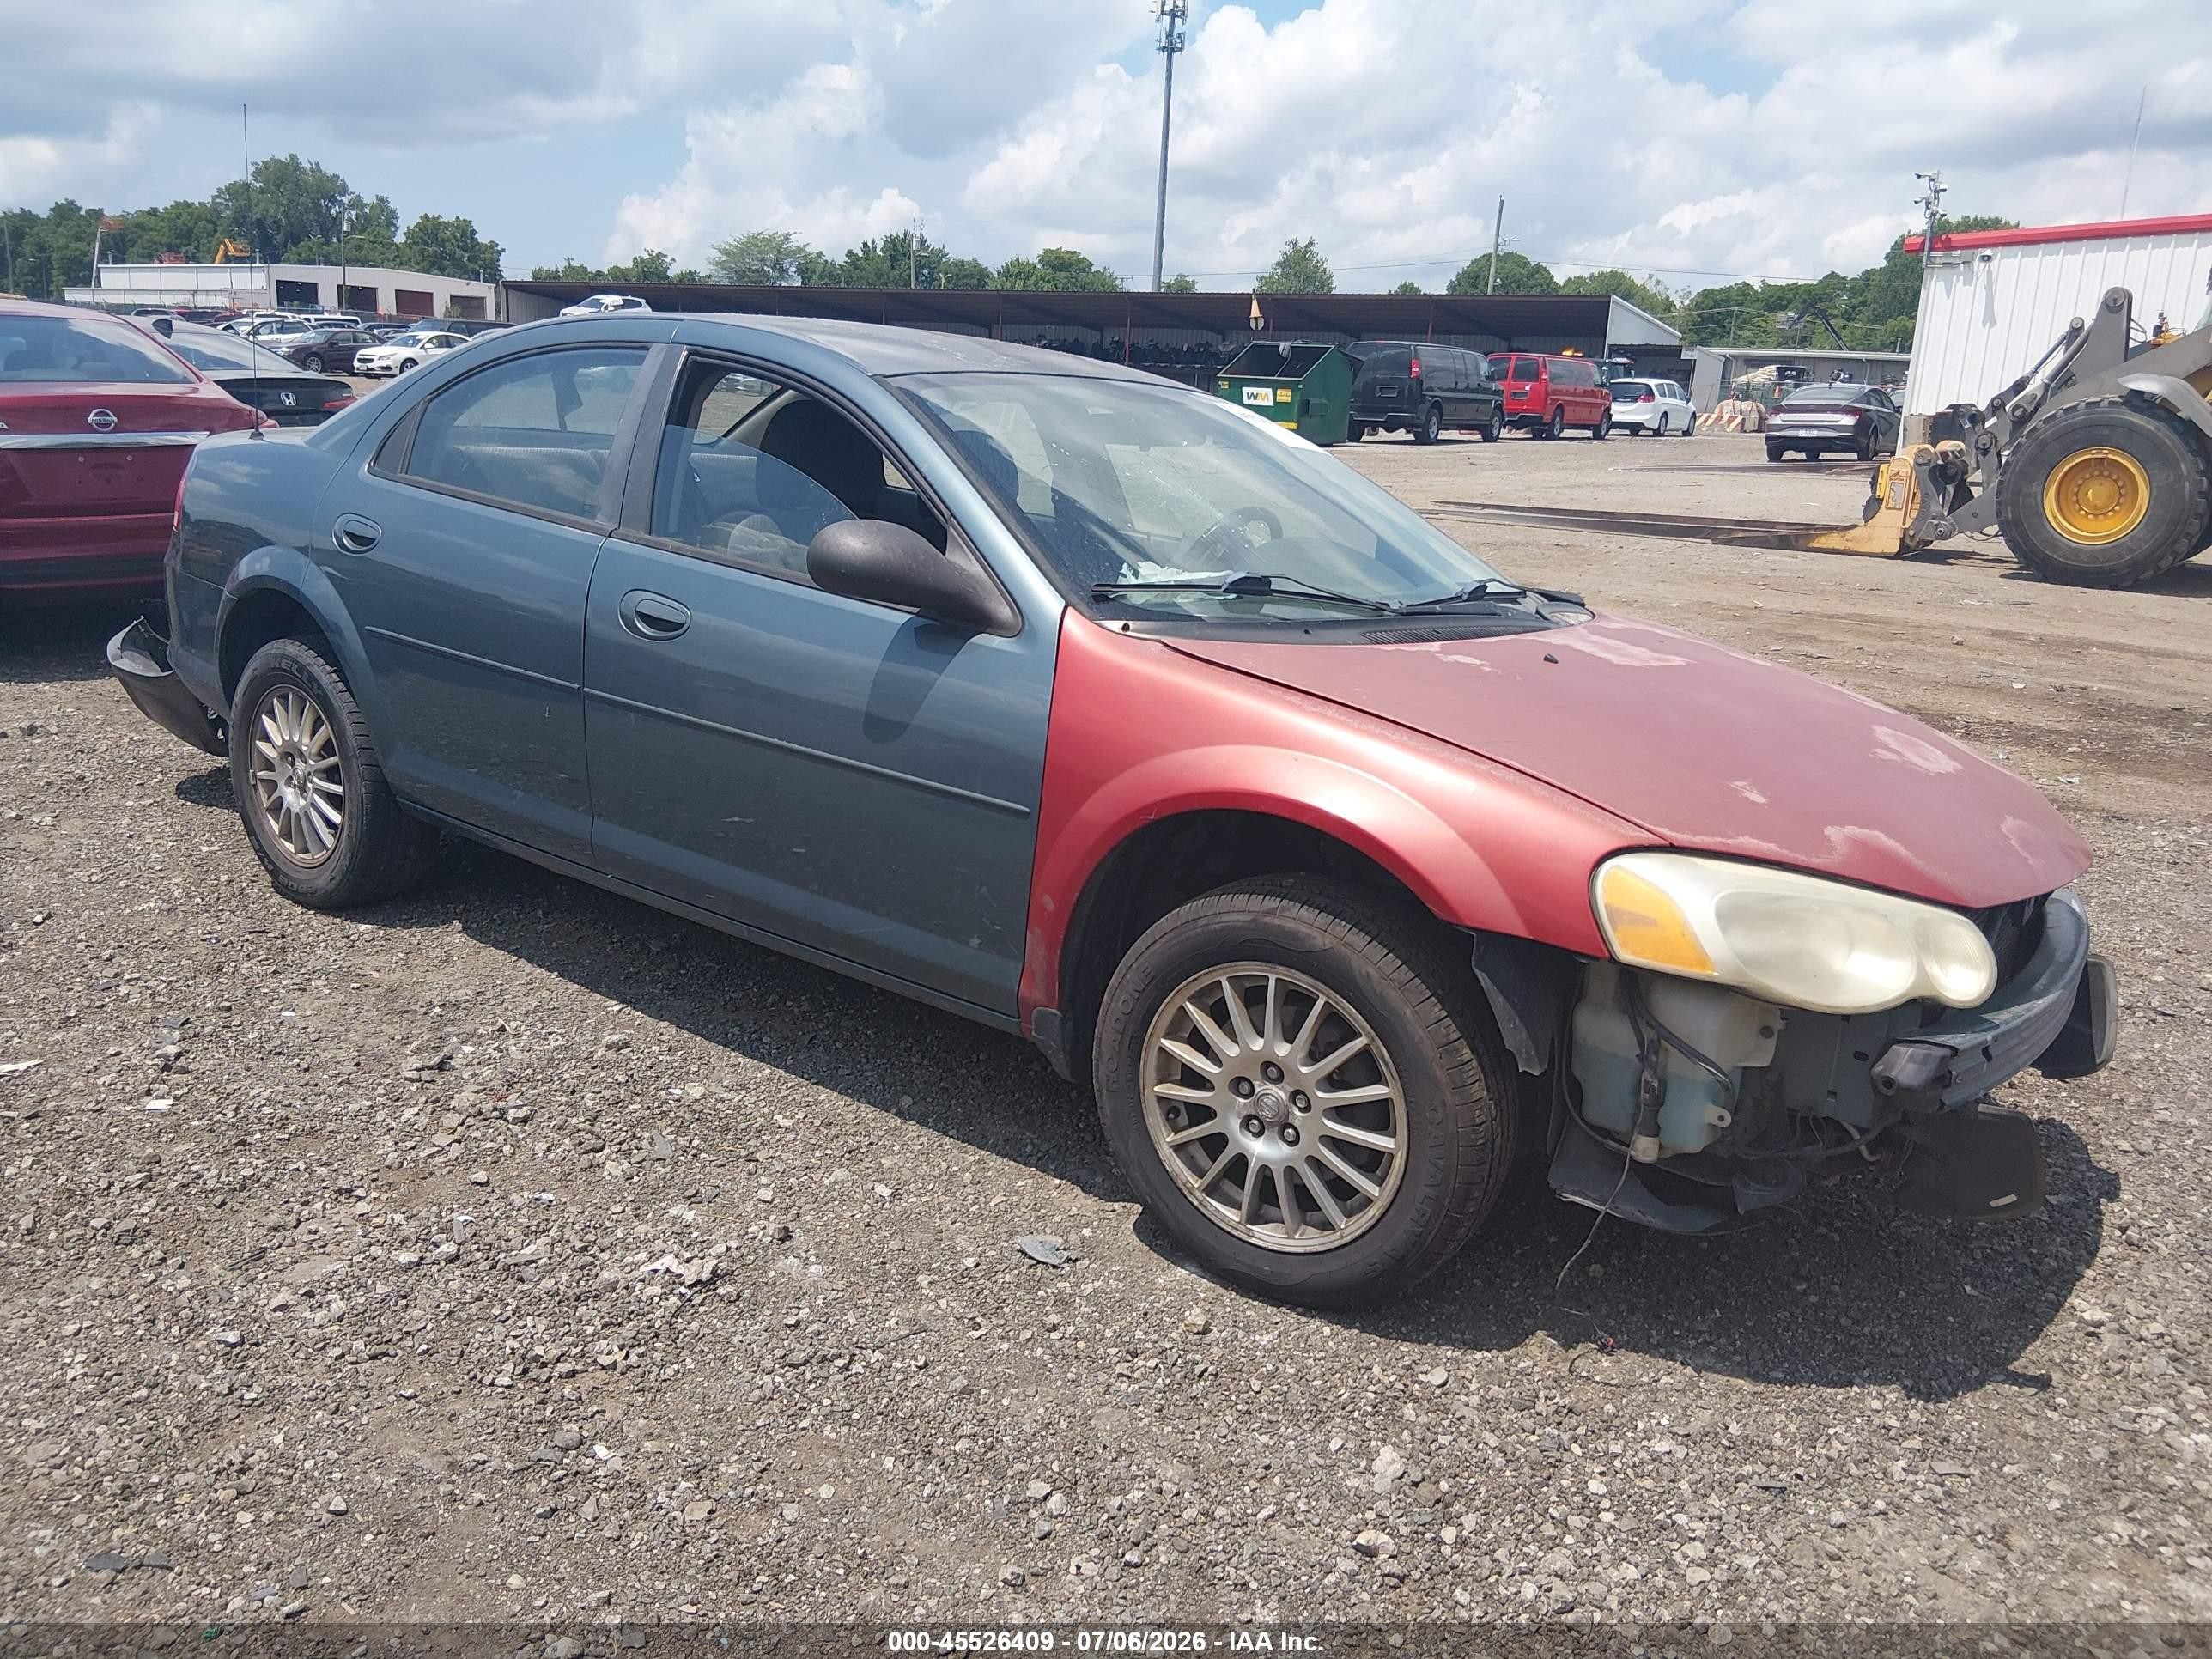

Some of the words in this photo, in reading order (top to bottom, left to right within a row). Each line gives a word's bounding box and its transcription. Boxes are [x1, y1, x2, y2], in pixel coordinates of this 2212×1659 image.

[1246, 392, 1270, 402] WM
[270, 658, 324, 696] KELLY
[1104, 965, 1156, 1093] ROADONE
[1404, 1102, 1446, 1244] CAVALRY
